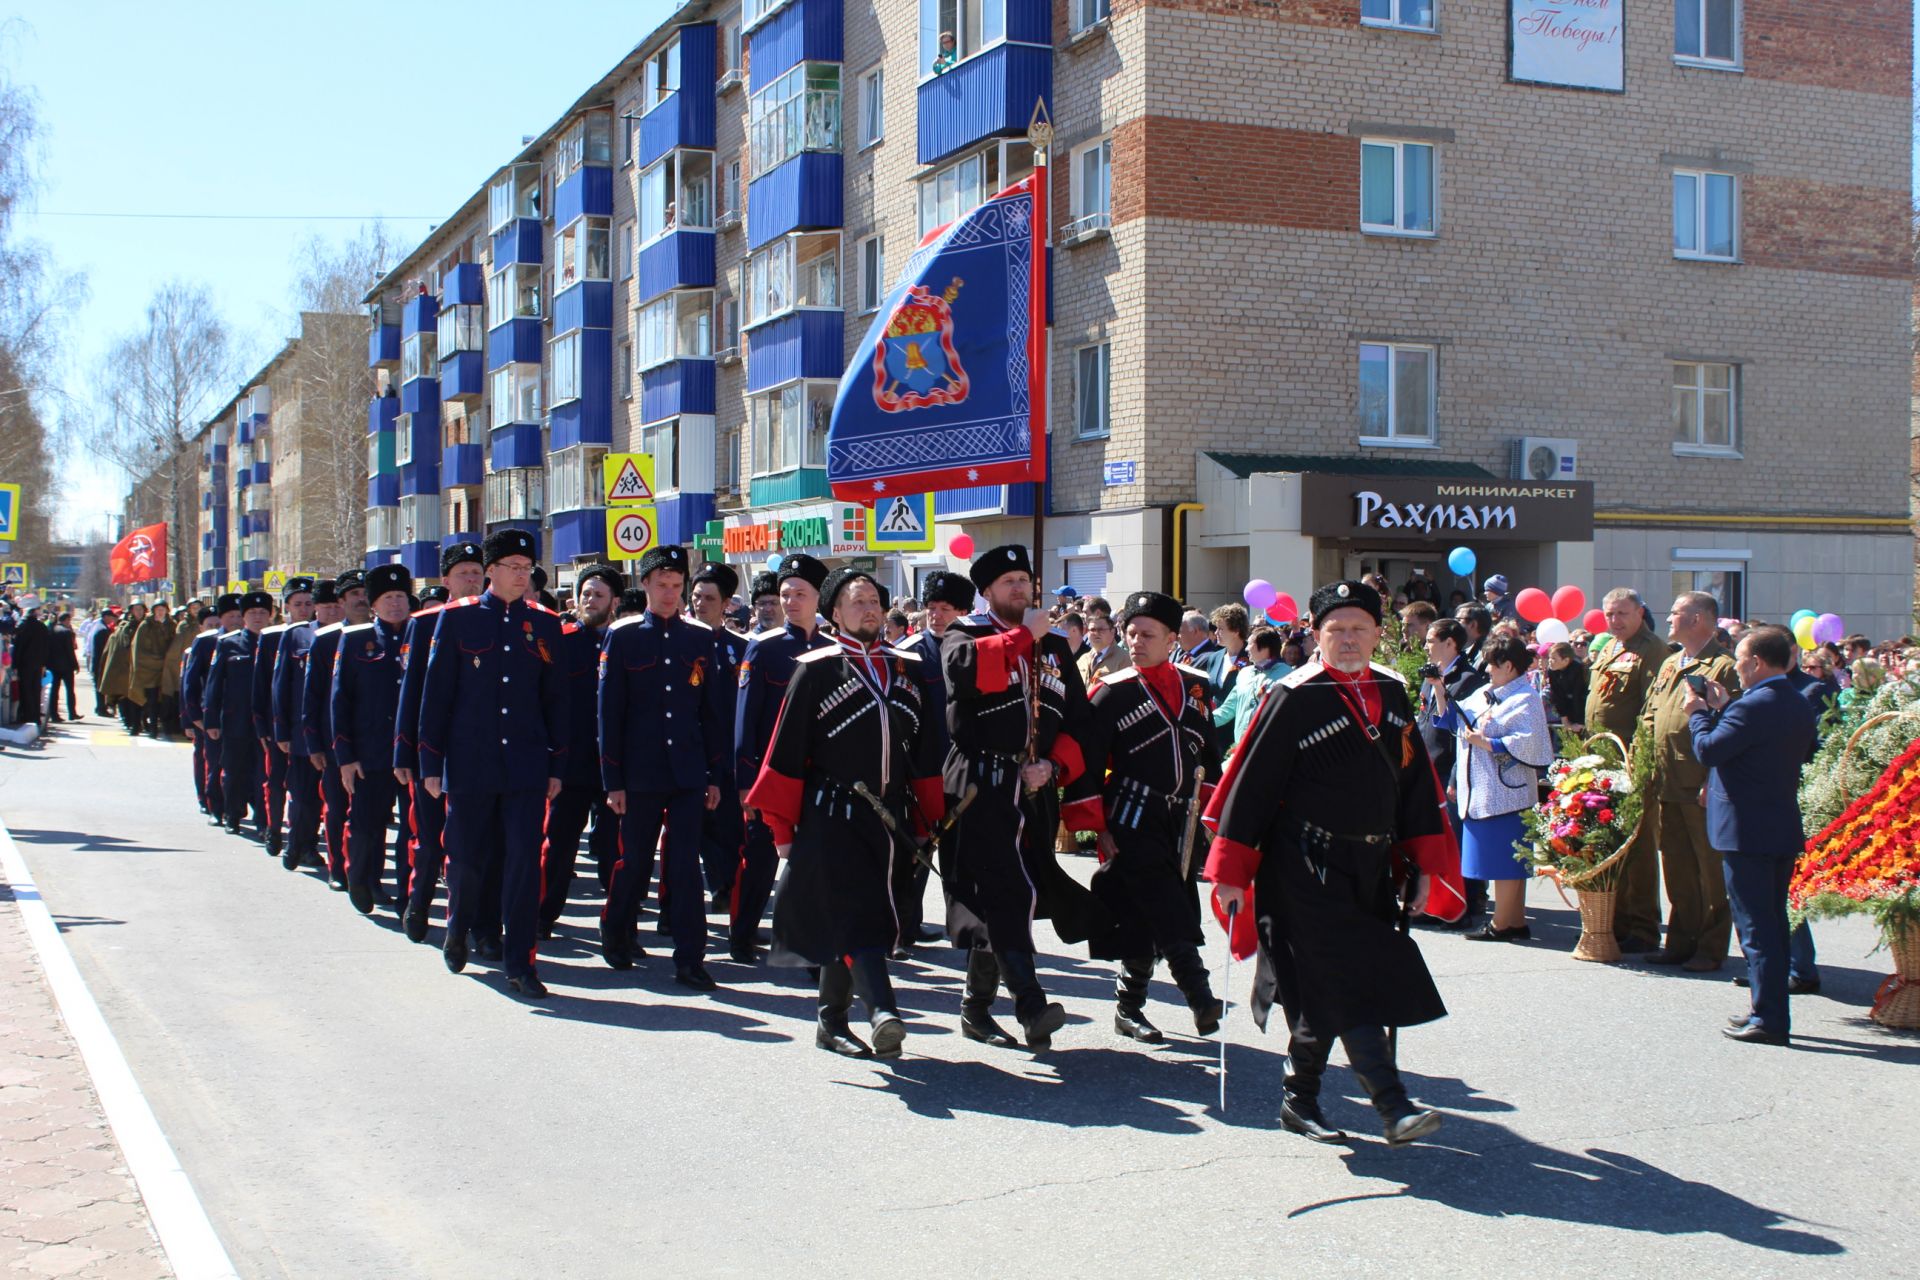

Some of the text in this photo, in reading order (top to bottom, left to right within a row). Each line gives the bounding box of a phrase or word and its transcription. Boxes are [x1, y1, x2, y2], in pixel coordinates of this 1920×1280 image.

[1518, 9, 1617, 51] Победы!
[1437, 485, 1576, 499] МИНИМАРКЕТ
[1356, 491, 1517, 534] Рахмат
[621, 526, 643, 541] 40
[722, 517, 825, 553] АПТЕКА ЭКОНА
[833, 544, 865, 552] ДАРУХ
